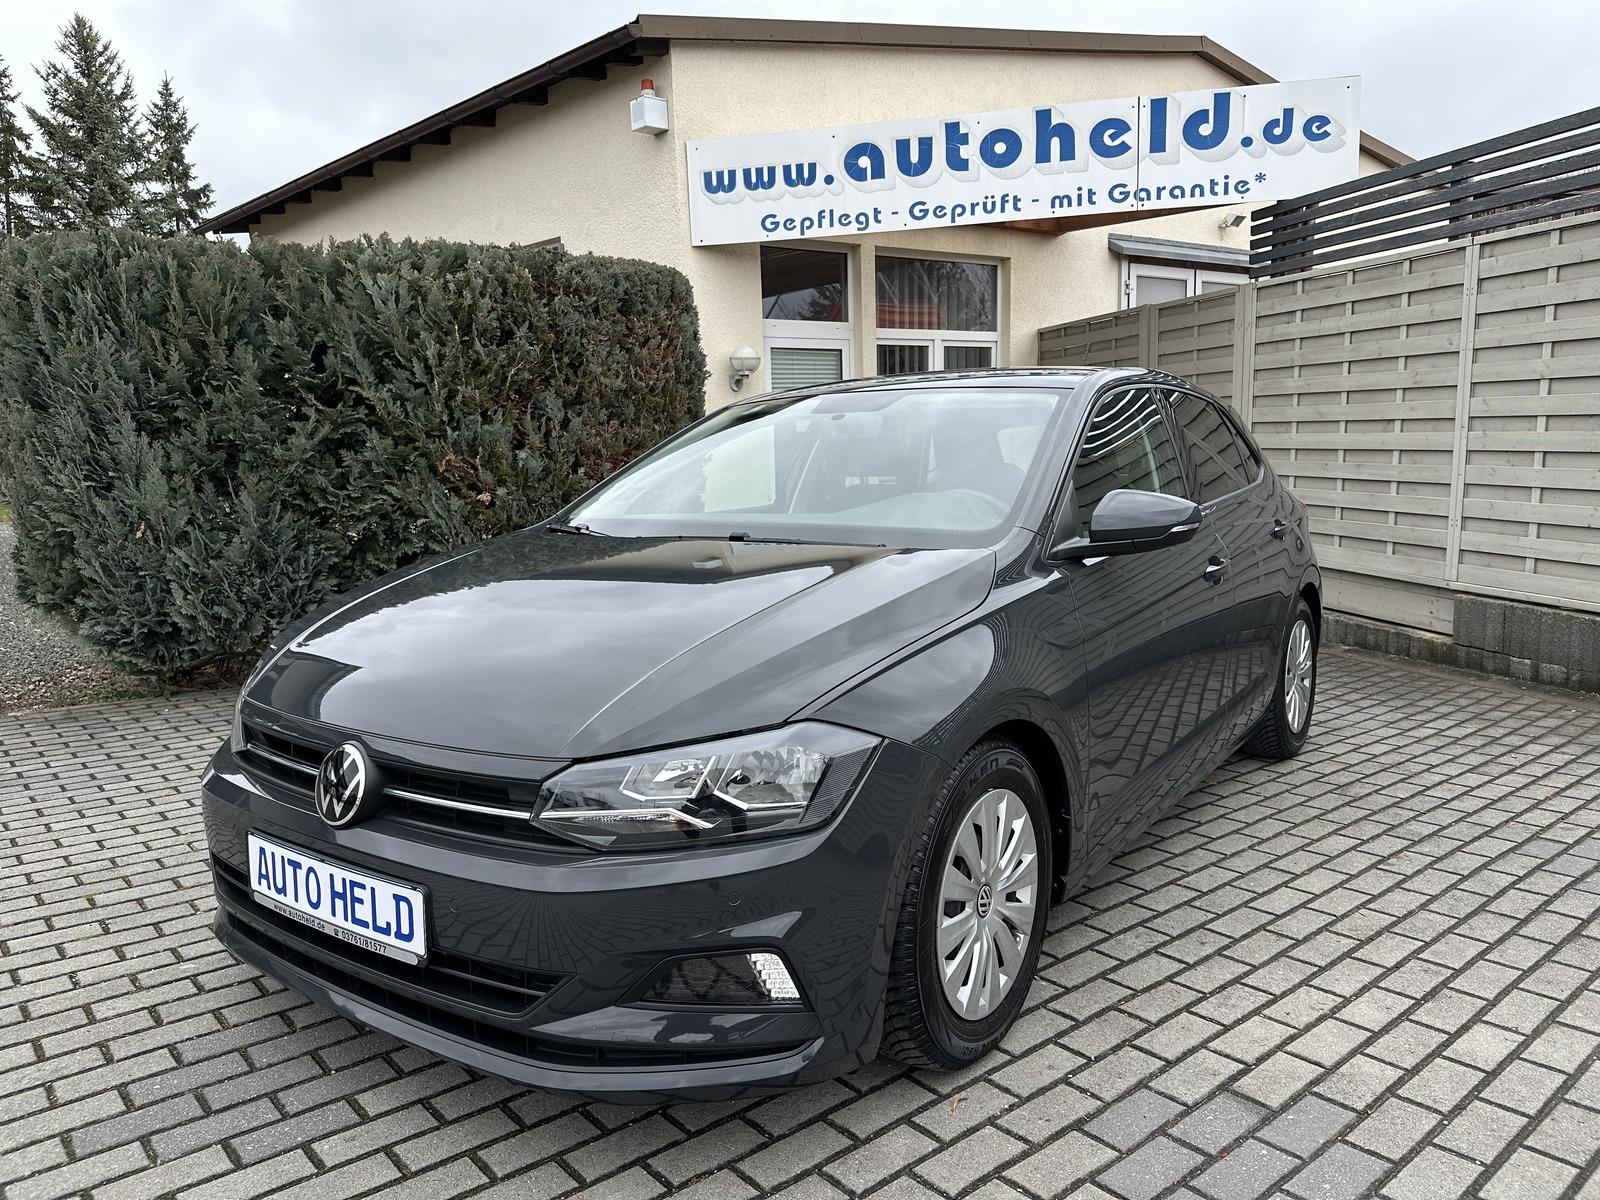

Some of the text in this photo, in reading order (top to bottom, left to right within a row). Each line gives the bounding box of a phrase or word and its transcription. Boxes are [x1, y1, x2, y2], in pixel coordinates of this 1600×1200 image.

[703, 91, 1333, 194] www.autoheld.de
[760, 207, 883, 235] Gepflegt
[908, 194, 1023, 222] Geprüft
[1051, 185, 1097, 208] mit
[256, 846, 416, 944] AUTO HELD
[273, 903, 388, 955] www.autoheld.de 03761/81577
